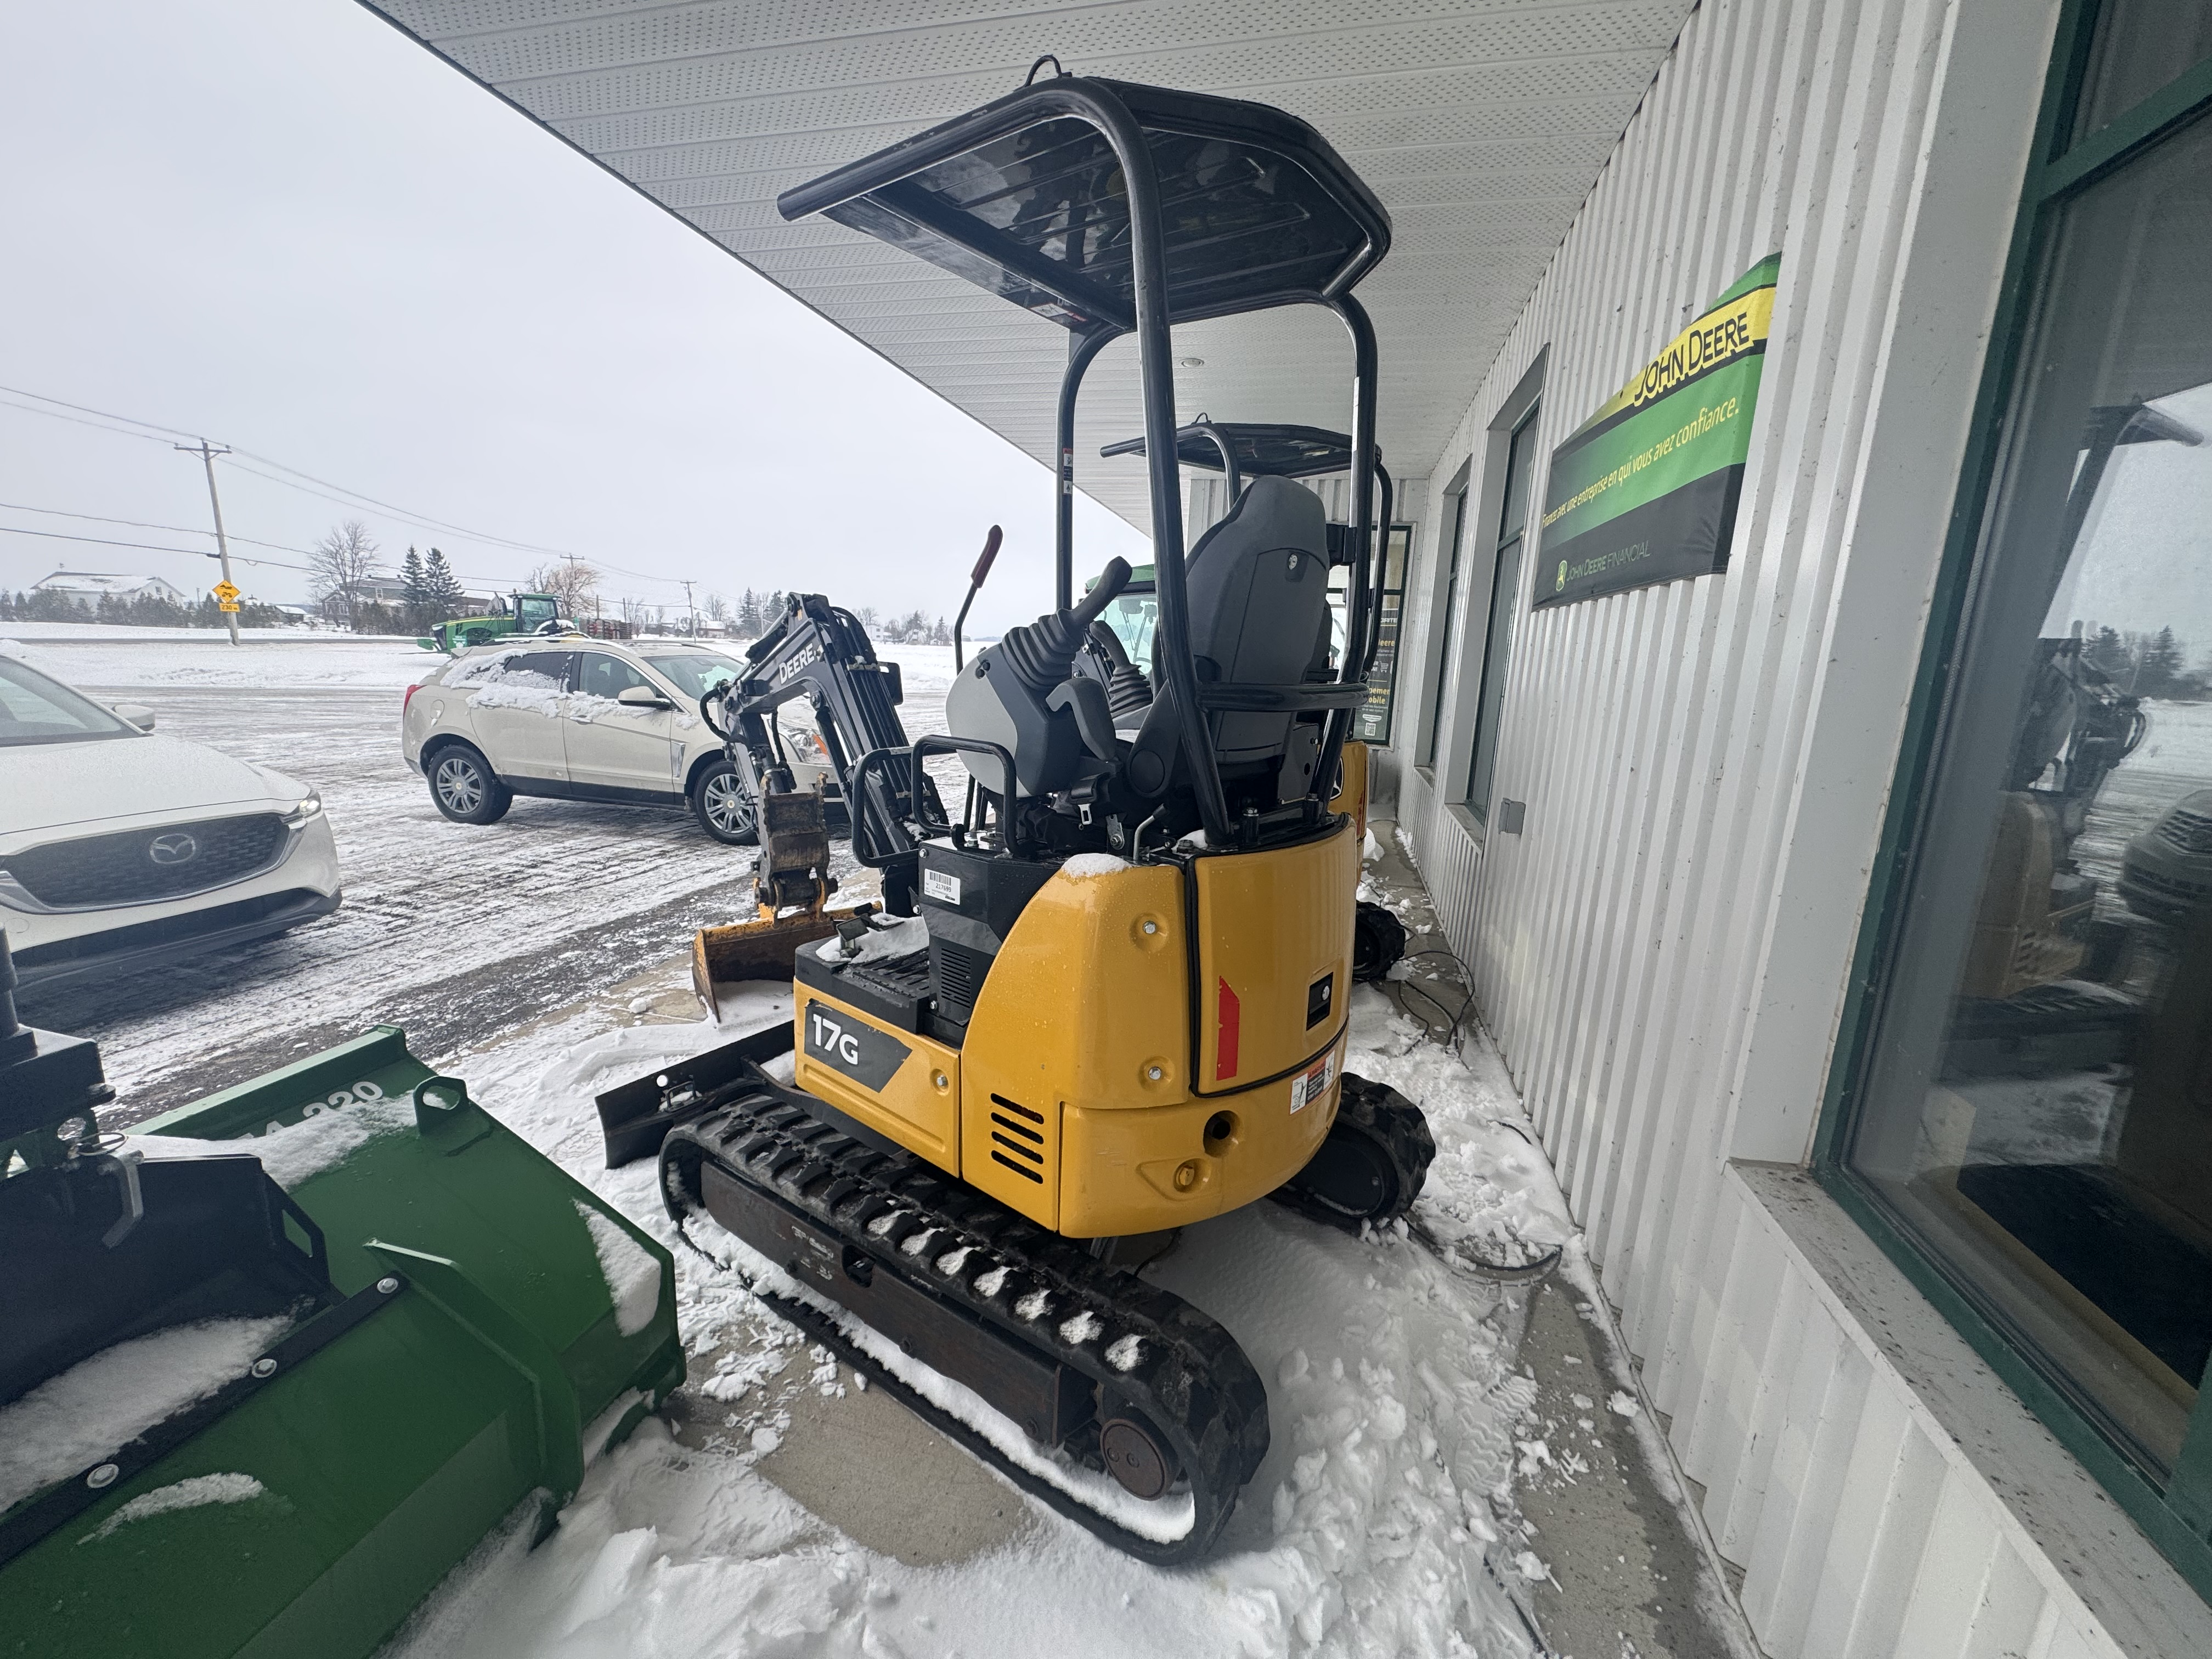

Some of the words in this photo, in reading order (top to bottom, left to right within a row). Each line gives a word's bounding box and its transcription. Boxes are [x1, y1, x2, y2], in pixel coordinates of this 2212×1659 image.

[1634, 344, 1685, 402] JOHN
[1688, 312, 1750, 371] DEERE
[1567, 495, 1578, 512] une
[1577, 475, 1607, 504] entreprise
[1608, 470, 1617, 487] en
[1618, 455, 1632, 487] qui
[1633, 448, 1654, 473] vous
[1654, 433, 1675, 461] avez
[1676, 397, 1739, 448] confiance.
[1567, 563, 1584, 582] JOHN
[1584, 555, 1607, 576] DEERE
[1607, 540, 1651, 569] FINANCIAL
[779, 643, 815, 684] DEERE
[813, 1013, 858, 1065] 17G
